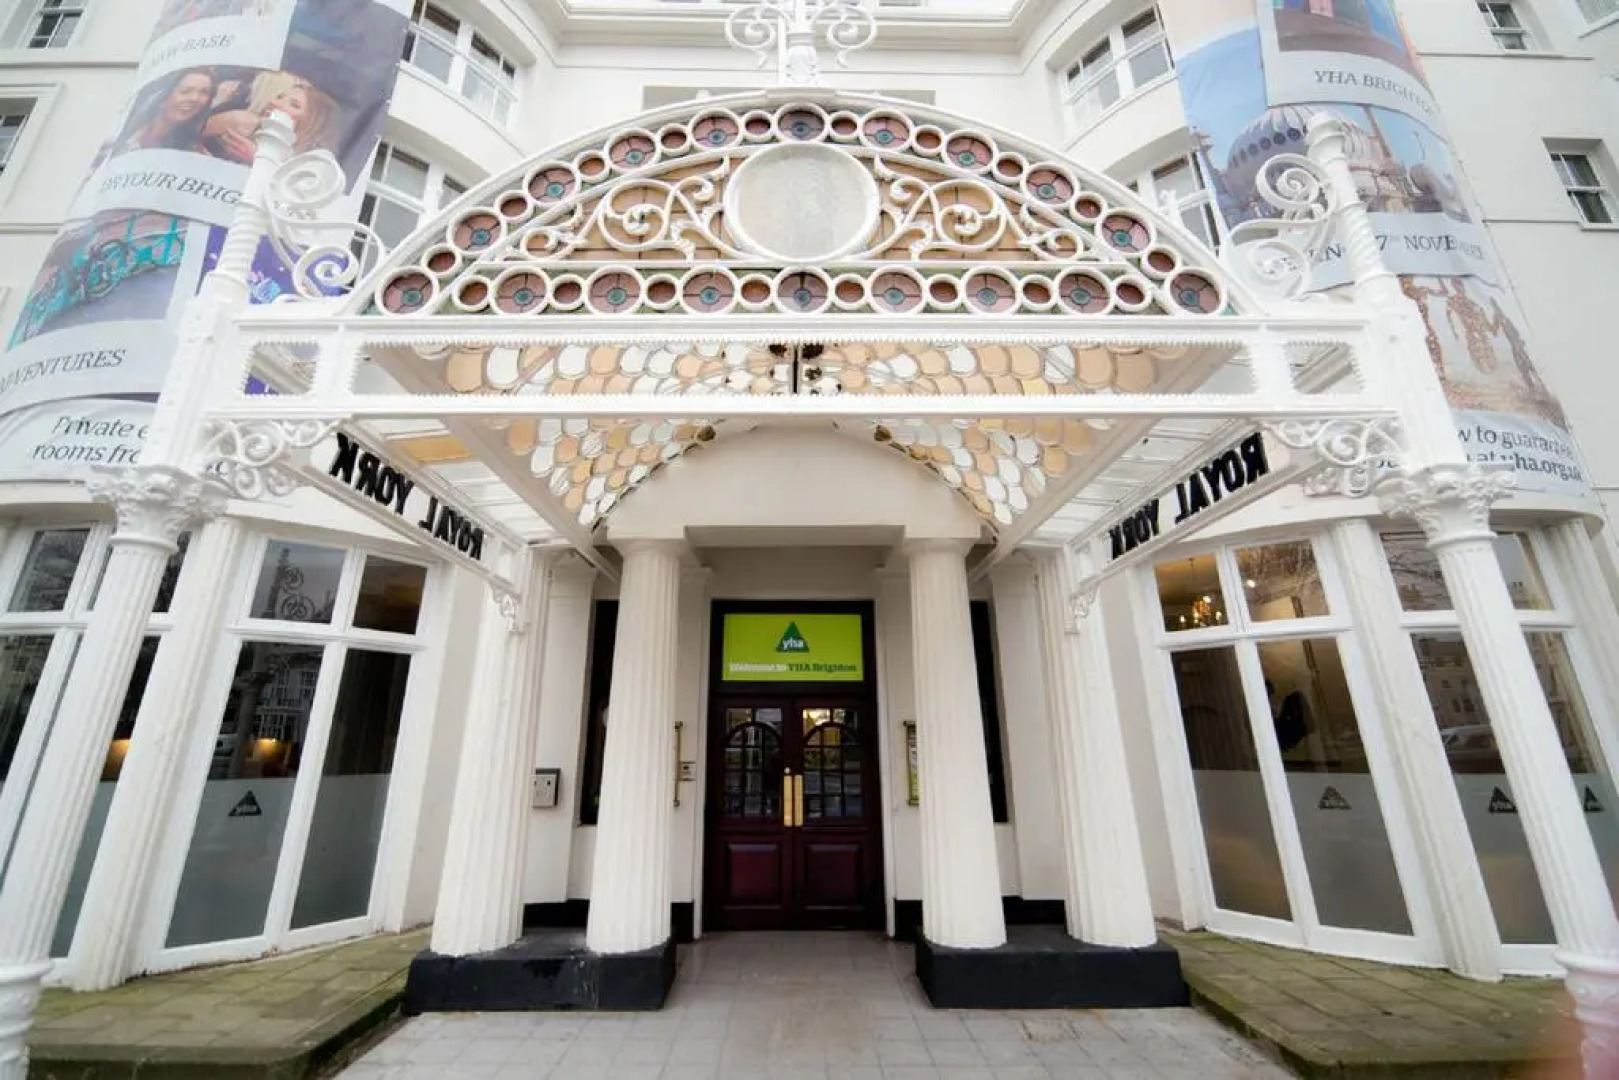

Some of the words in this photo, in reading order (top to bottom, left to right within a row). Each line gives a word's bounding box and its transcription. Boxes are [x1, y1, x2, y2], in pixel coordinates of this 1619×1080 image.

[1314, 70, 1358, 86] YHA
[120, 171, 177, 189] YOUR
[177, 176, 244, 205] BRIG
[52, 415, 135, 438] Private
[1475, 424, 1497, 445] to
[32, 443, 106, 461] rooms
[782, 637, 804, 651] yha
[788, 662, 810, 672] YHA
